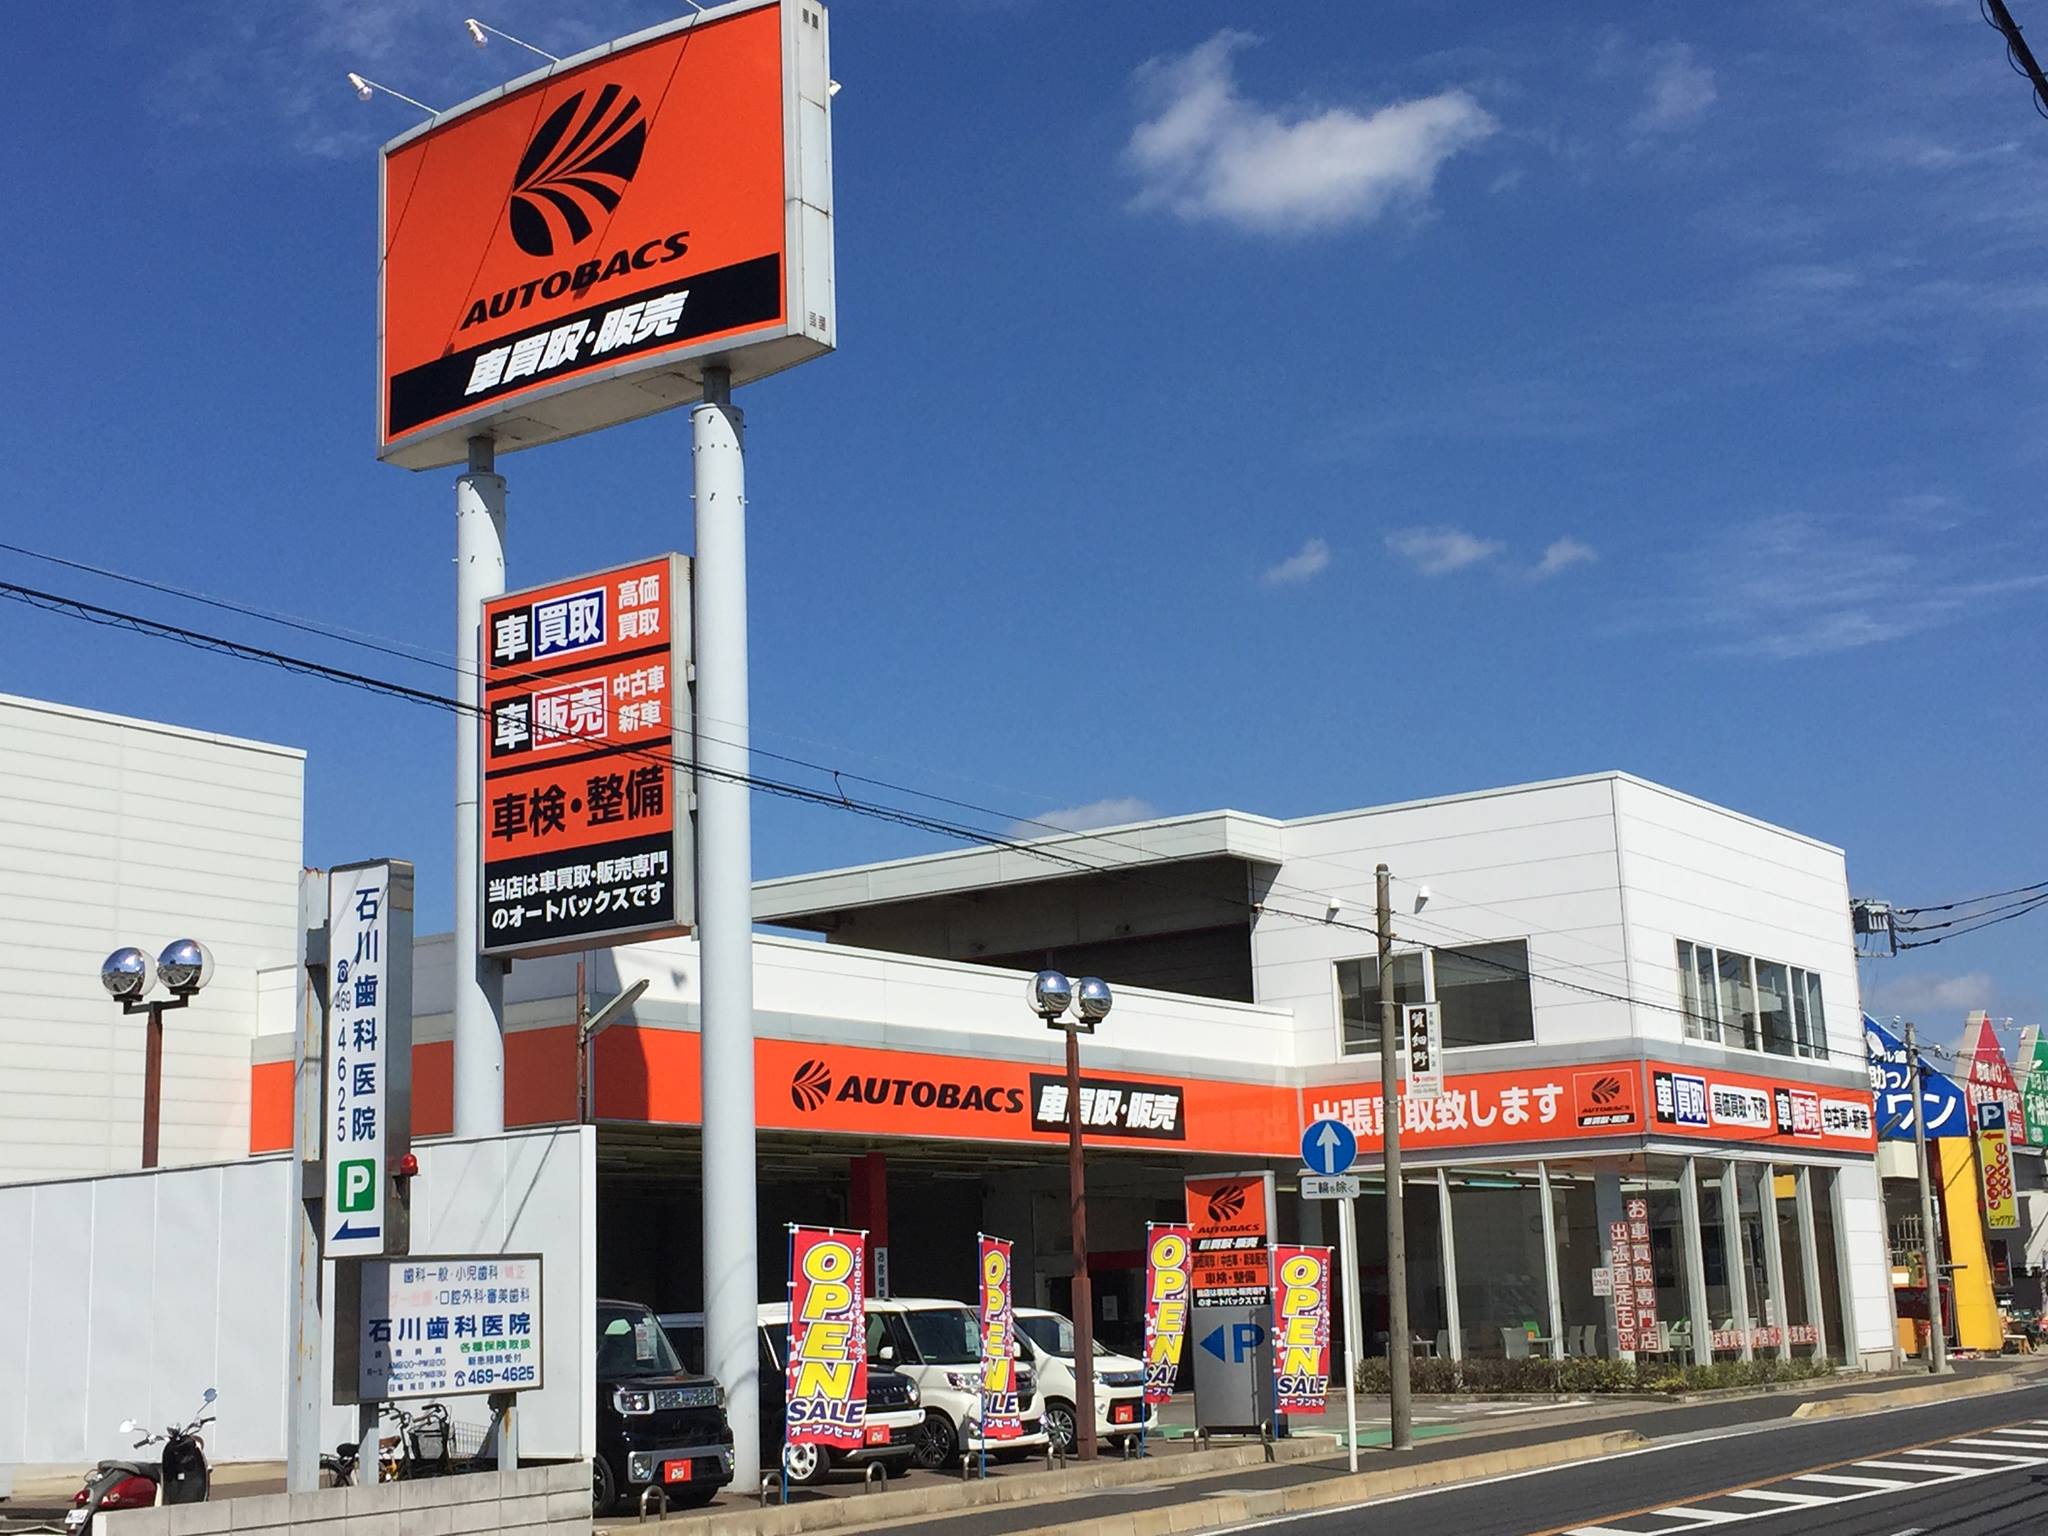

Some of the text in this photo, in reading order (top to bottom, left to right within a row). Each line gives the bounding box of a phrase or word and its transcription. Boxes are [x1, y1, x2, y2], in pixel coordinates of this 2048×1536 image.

[460, 231, 690, 331] AUTOBACS
[464, 289, 690, 396] 車買取・販売
[618, 574, 660, 610] 高価
[618, 608, 660, 641] 買取
[613, 665, 665, 700] 中古車
[618, 700, 661, 733] 新車
[492, 765, 664, 842] 車検・整備
[489, 850, 668, 903] 当店は車買取・販売専門
[492, 881, 665, 929] のオートバックスです
[352, 887, 380, 1142] 石川歯科医院
[835, 1075, 1025, 1113] AUTOBACS
[1996, 1144, 2011, 1198] リサイクル
[1197, 1223, 1259, 1234] AUTOBACS
[793, 1240, 856, 1402] OPEN
[1150, 1235, 1187, 1365] OPEN
[1281, 1256, 1324, 1377] OPEN
[369, 1312, 531, 1342] 石川歯科医院
[984, 1250, 1010, 1395] OPEN
[468, 1366, 535, 1385] 469-4625
[1277, 1375, 1329, 1397] SALE
[788, 1399, 867, 1426] SALE
[791, 1425, 863, 1439] オープンセール
